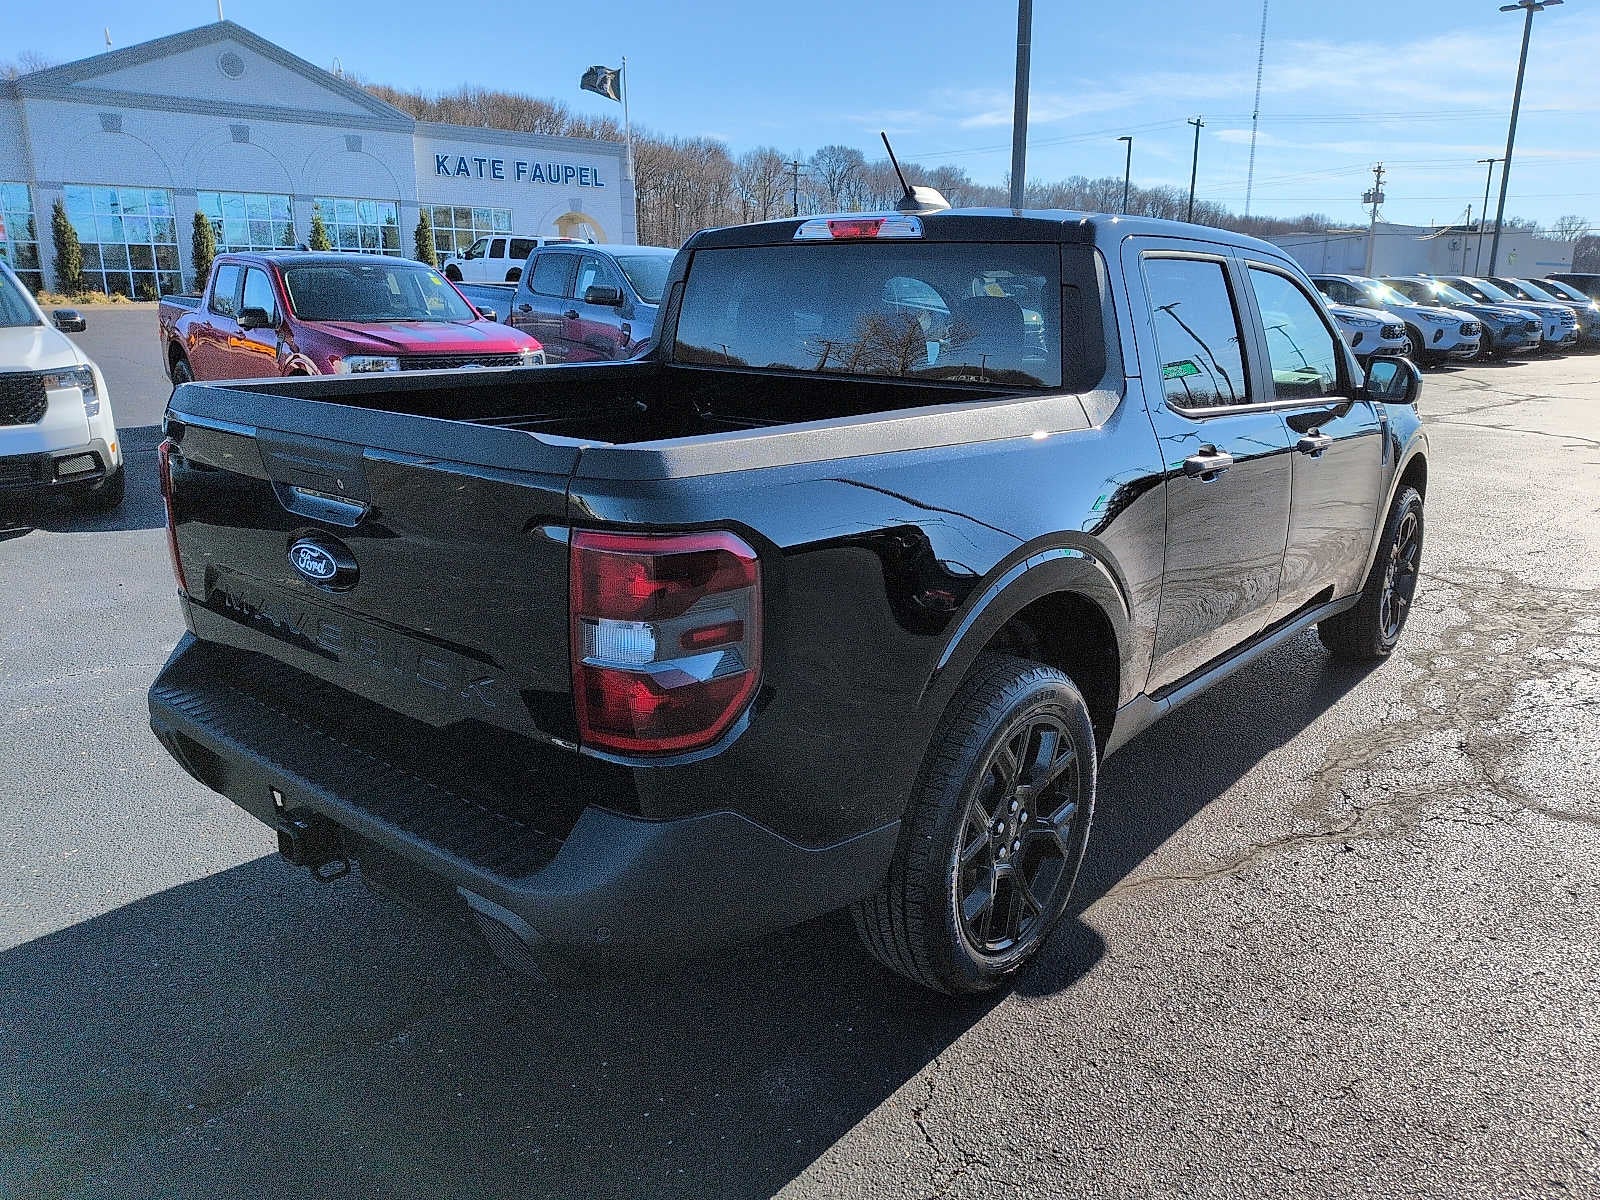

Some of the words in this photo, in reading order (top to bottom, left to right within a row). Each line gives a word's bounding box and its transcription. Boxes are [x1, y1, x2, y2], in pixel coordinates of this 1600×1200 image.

[434, 153, 505, 180] KATE
[514, 161, 605, 188] FAUPEL
[298, 548, 327, 575] Ford
[223, 583, 497, 708] MAVERICK
